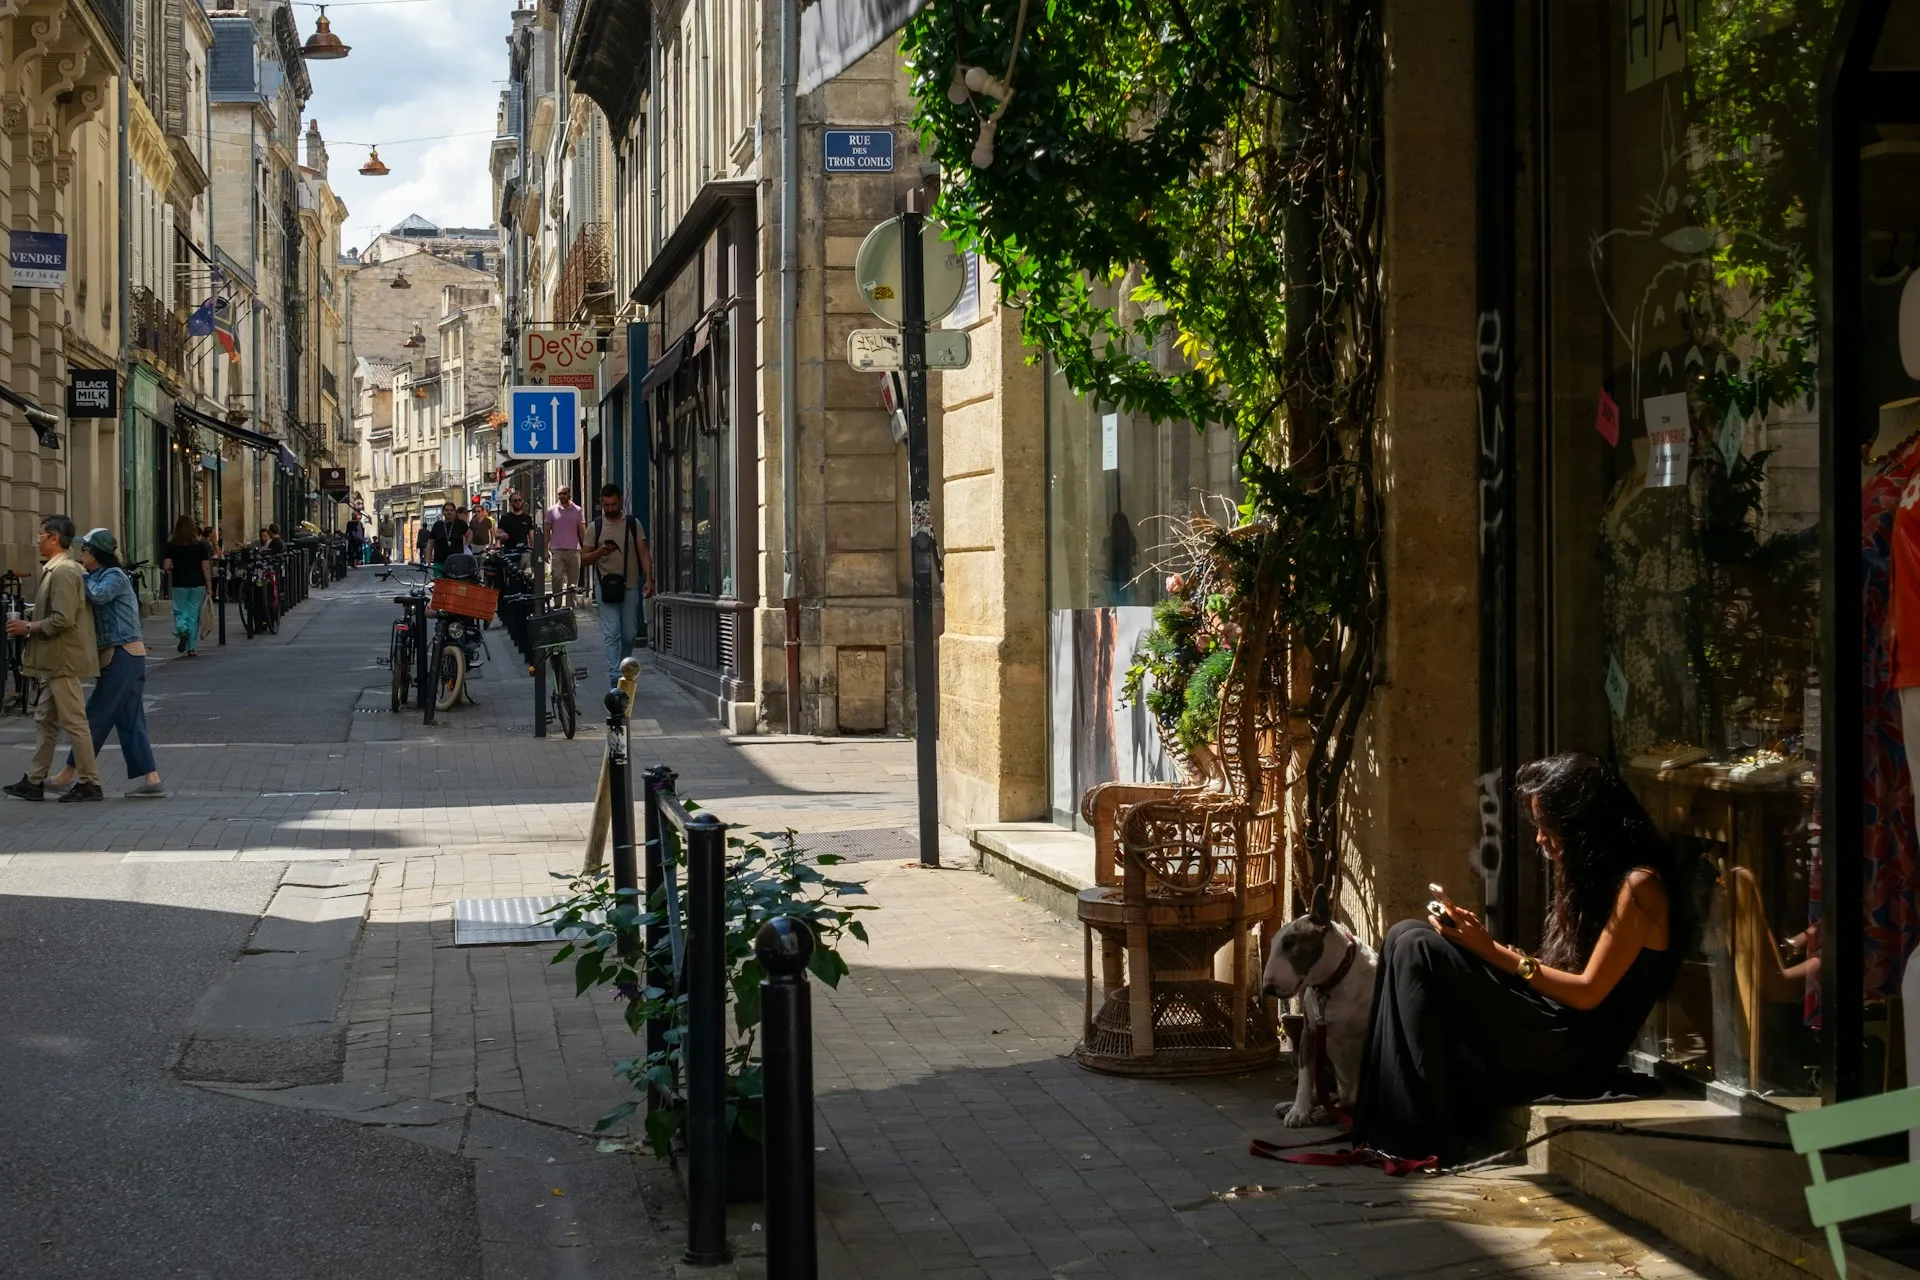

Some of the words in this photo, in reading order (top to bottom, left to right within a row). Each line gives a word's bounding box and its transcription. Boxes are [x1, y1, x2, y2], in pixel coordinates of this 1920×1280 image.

[849, 135, 871, 145] RUE
[828, 156, 855, 167] TROIS
[858, 156, 890, 167] CONILS
[11, 252, 61, 265] VENDRE
[550, 375, 592, 383] DESTOCKAGE
[75, 380, 109, 389] BLACK
[78, 391, 106, 400] MILK
[1651, 428, 1686, 446] BRADERIE
